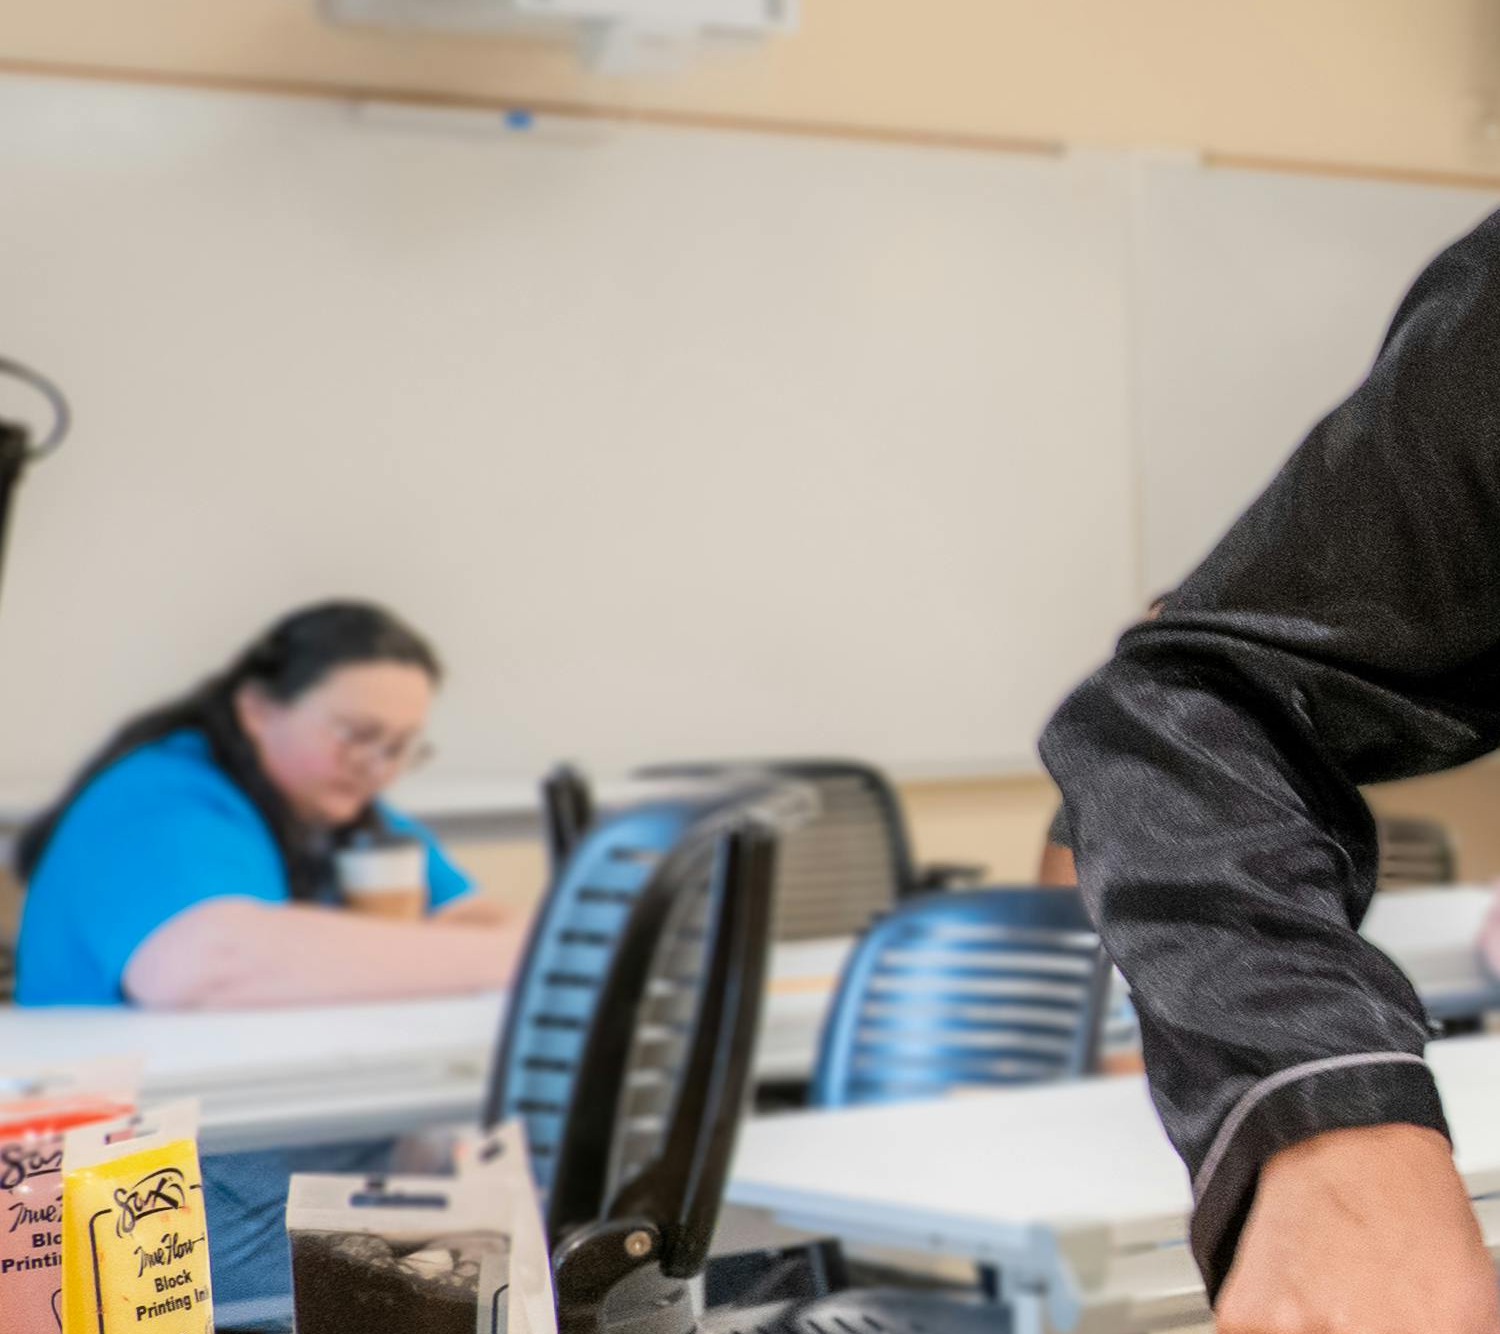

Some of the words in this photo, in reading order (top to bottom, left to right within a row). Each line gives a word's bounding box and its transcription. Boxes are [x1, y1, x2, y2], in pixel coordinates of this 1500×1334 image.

[32, 1232, 62, 1247] Blo
[1, 1251, 62, 1273] Printi
[154, 1269, 192, 1292] Block
[136, 1295, 192, 1322] Printing
